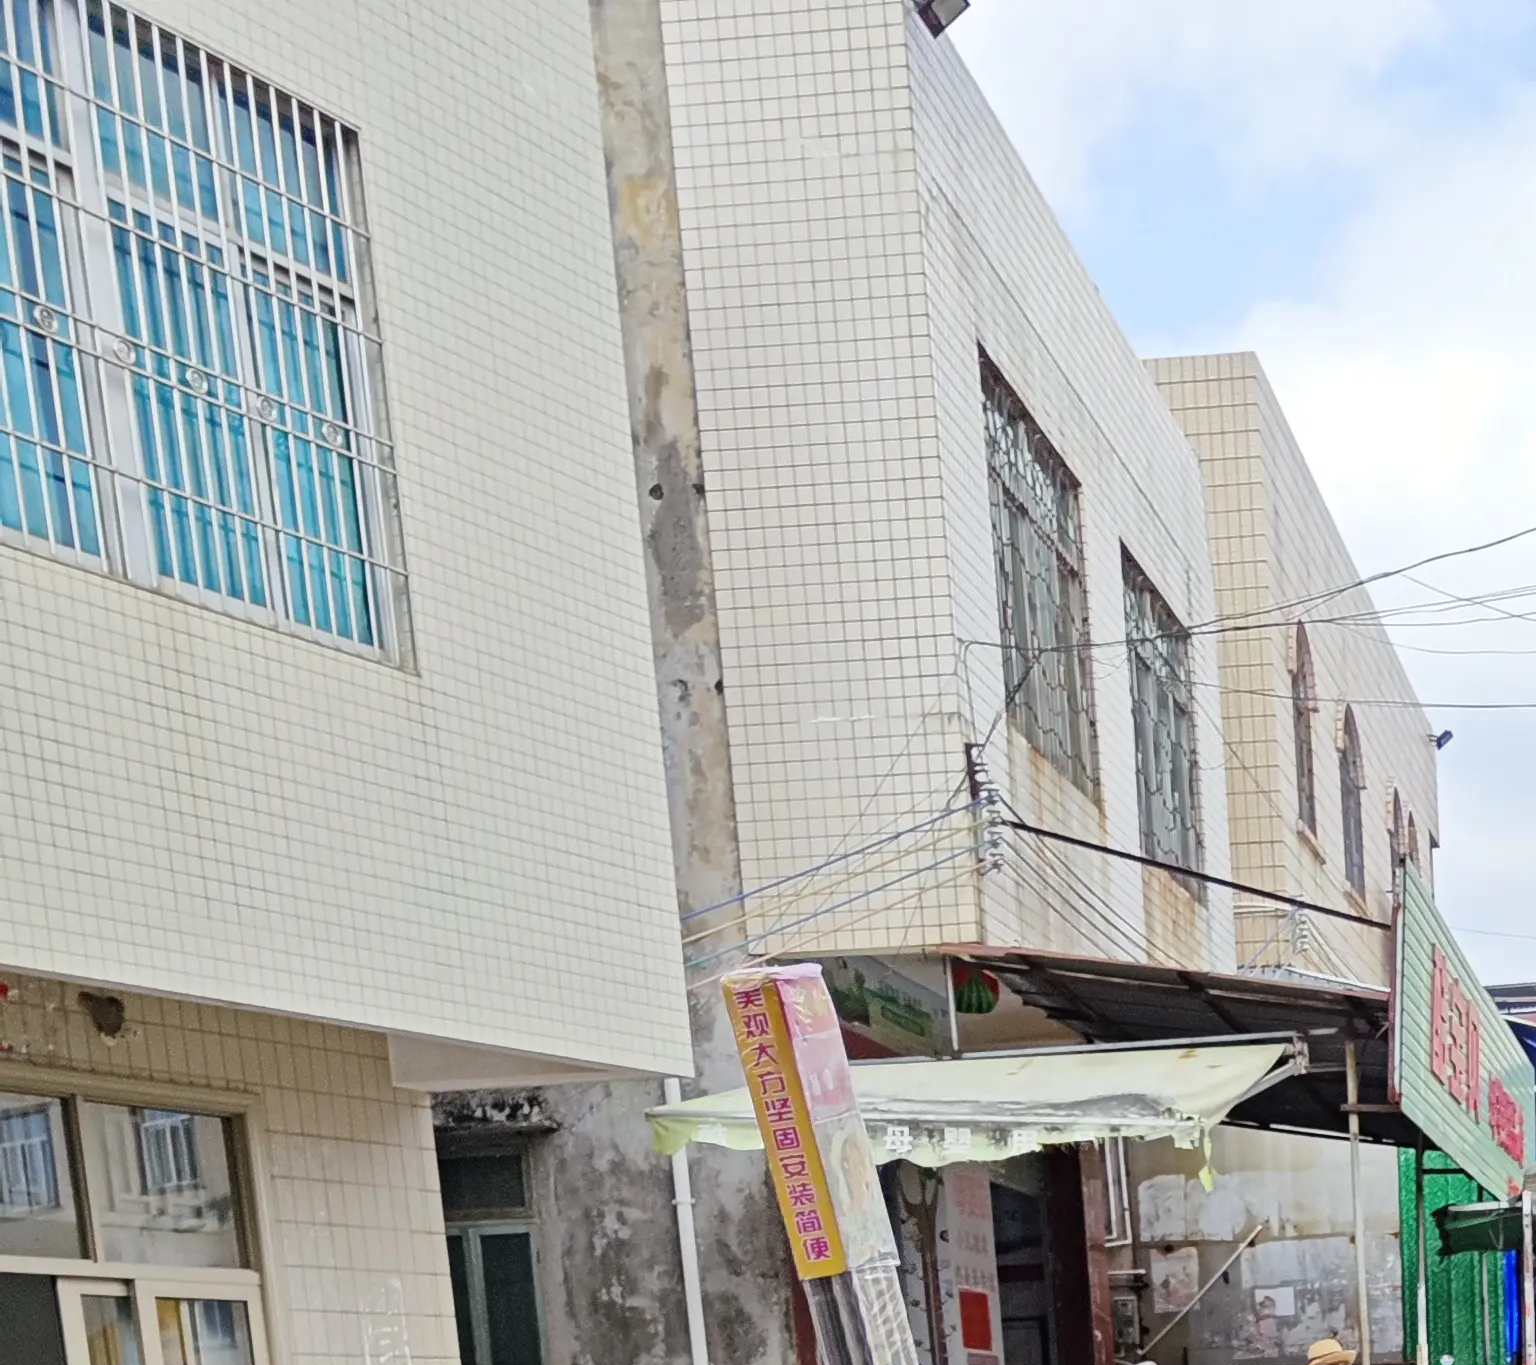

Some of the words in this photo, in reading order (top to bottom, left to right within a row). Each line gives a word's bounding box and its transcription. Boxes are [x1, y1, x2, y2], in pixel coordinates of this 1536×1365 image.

[733, 986, 831, 1262] 美观大方坚固安装简便
